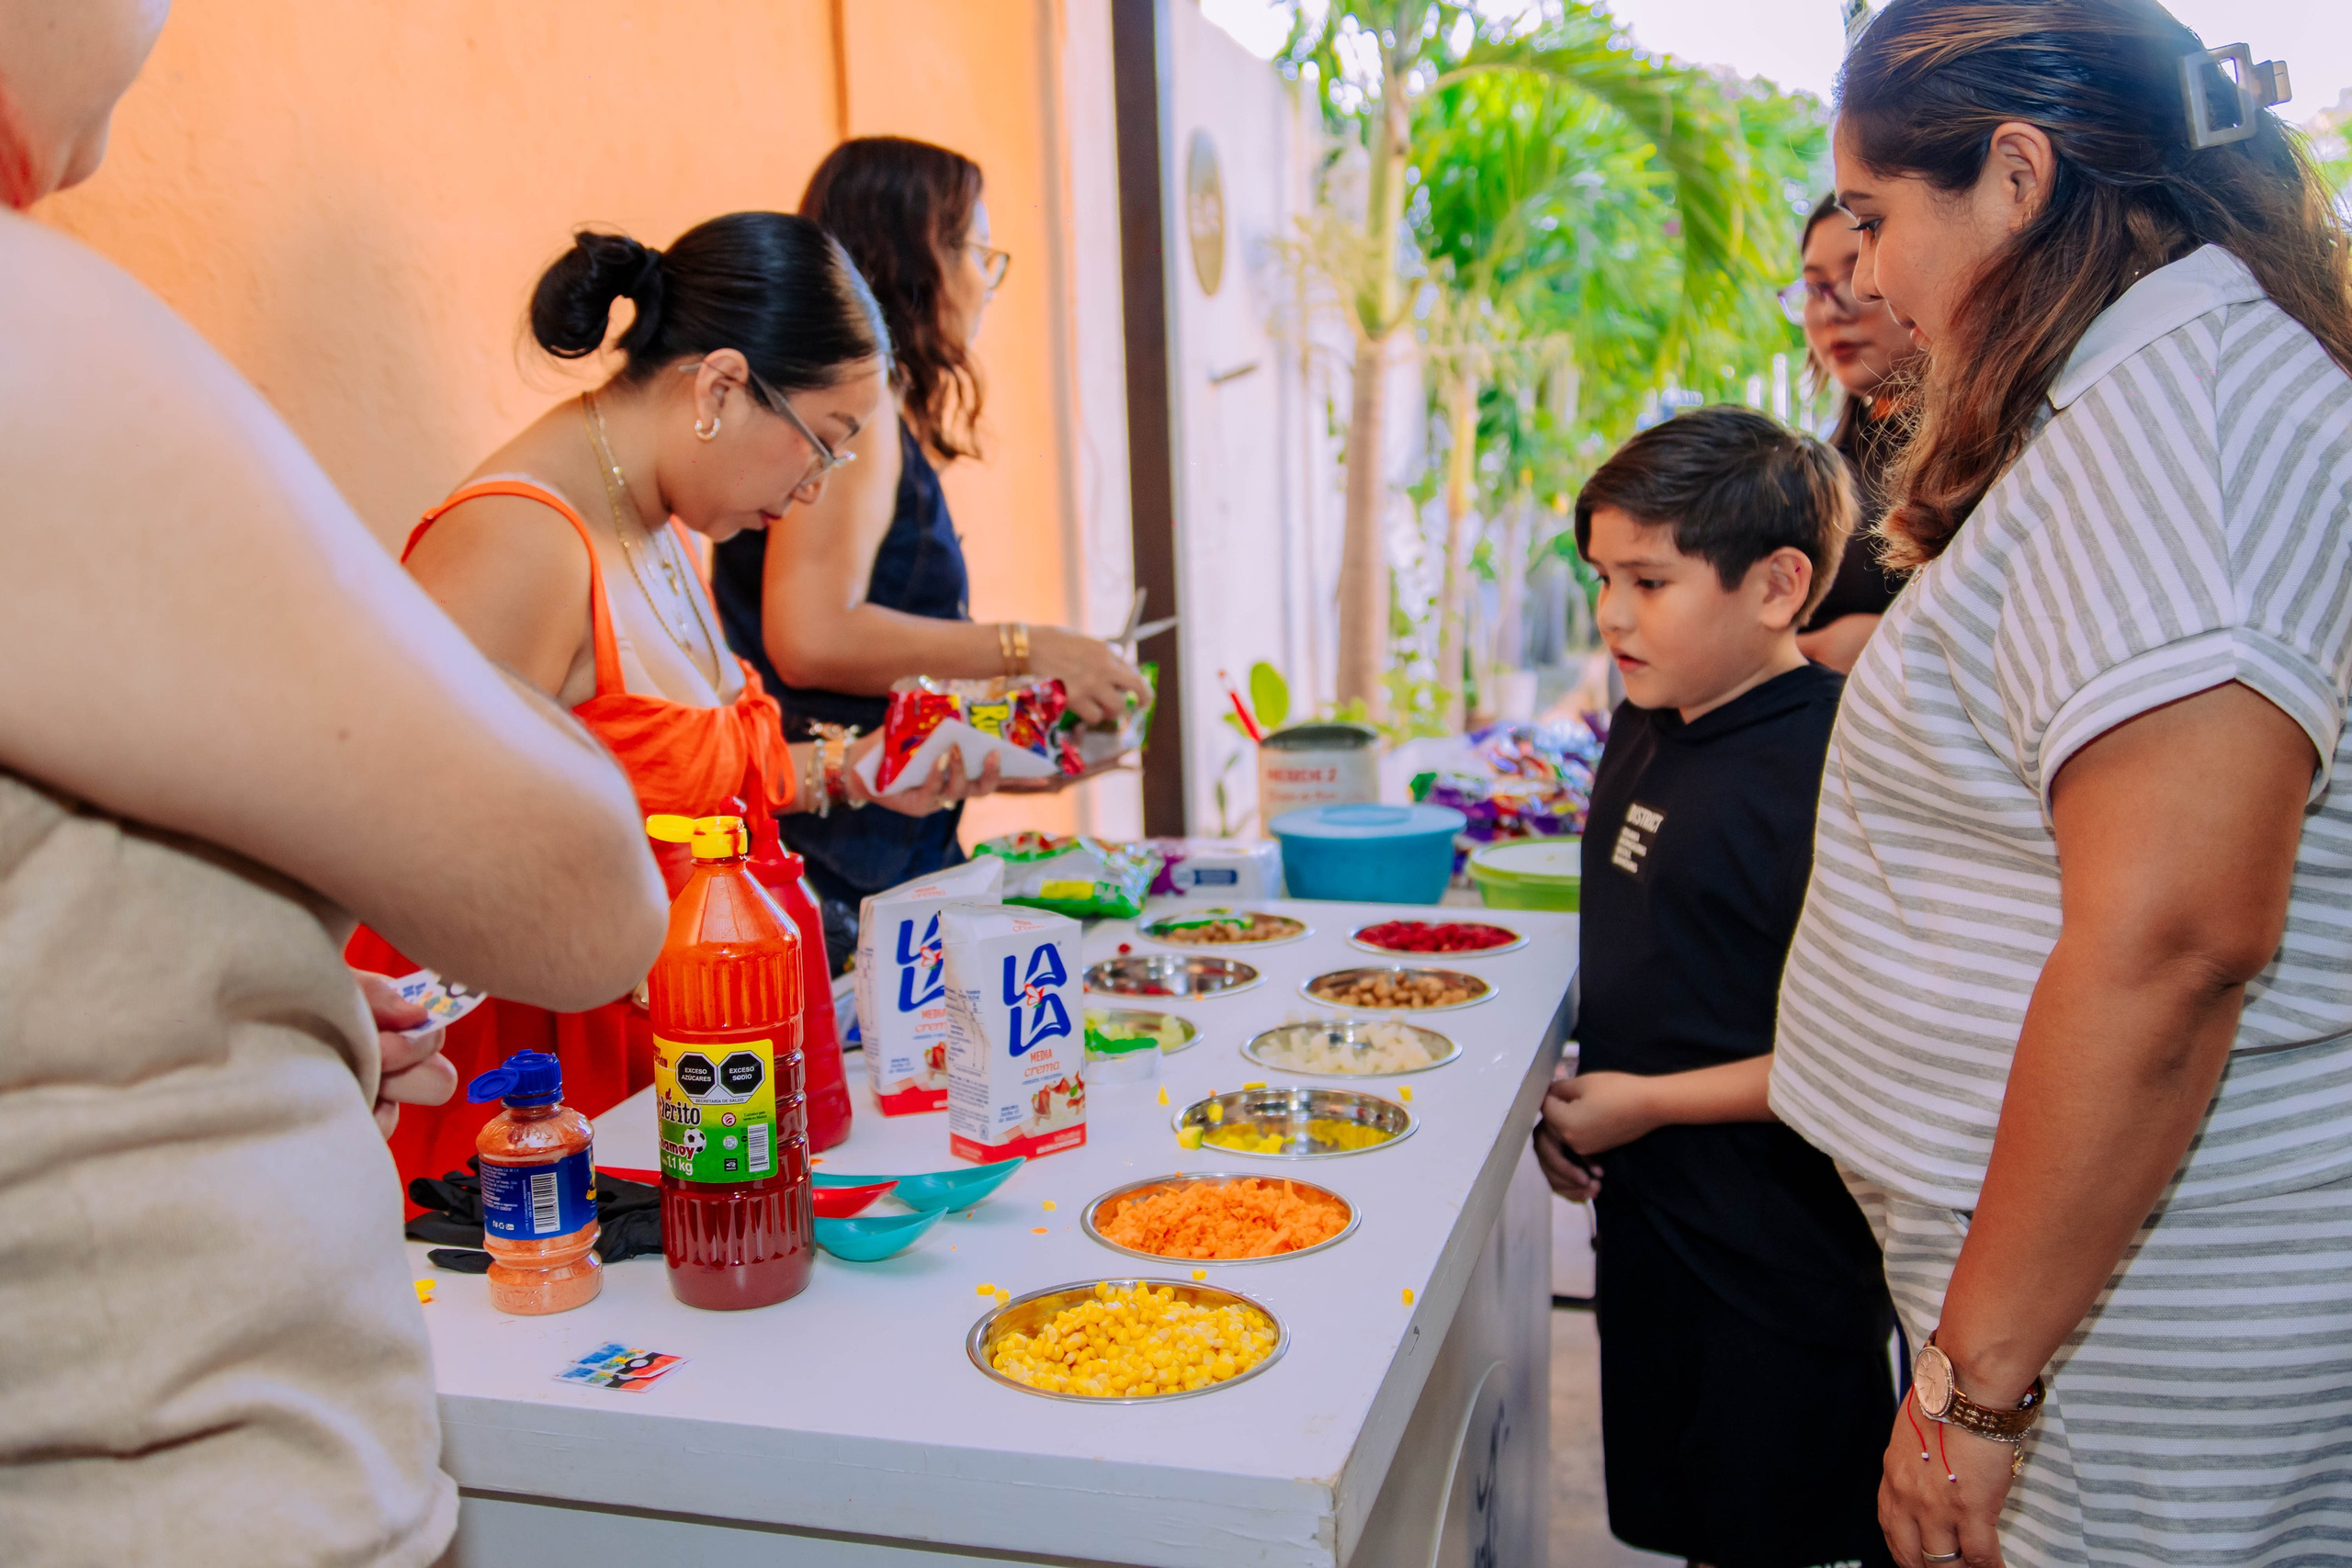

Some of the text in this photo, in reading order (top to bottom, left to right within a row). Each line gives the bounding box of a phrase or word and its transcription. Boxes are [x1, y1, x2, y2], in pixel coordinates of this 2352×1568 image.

[1626, 803, 1664, 833] DISTRICT
[915, 1021, 947, 1033] crem
[1030, 1048, 1053, 1064] MEDIA
[684, 1066, 707, 1075] EXCESO
[729, 1066, 755, 1074] EXCESO
[1023, 1060, 1060, 1077] crema
[681, 1074, 712, 1082] AZÚCARES
[732, 1073, 752, 1081] SODIO
[661, 1097, 701, 1125] lerito
[666, 1155, 676, 1169] 1.1
[678, 1158, 694, 1176] kg
